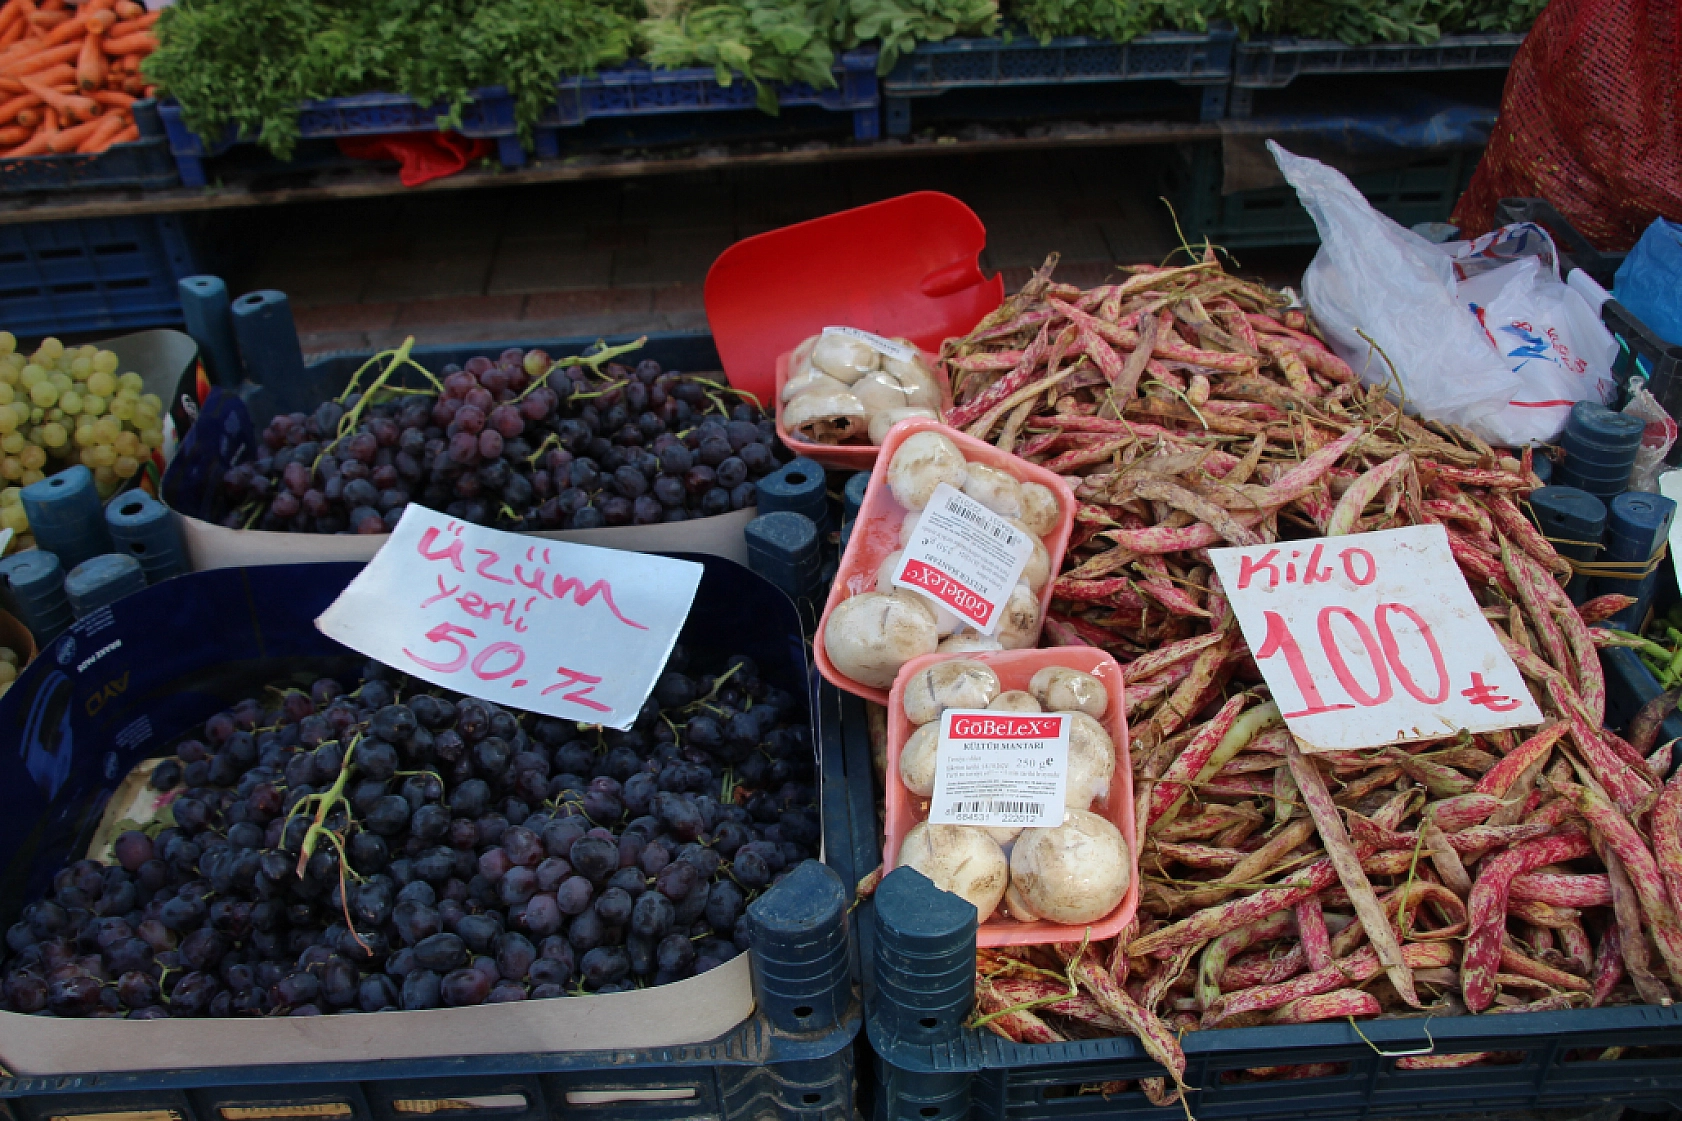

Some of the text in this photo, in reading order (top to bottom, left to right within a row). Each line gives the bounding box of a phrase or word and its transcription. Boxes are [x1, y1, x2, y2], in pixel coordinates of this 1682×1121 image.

[420, 574, 538, 633] yerli
[1255, 602, 1450, 719] 100
[1016, 757, 1036, 768] 250
